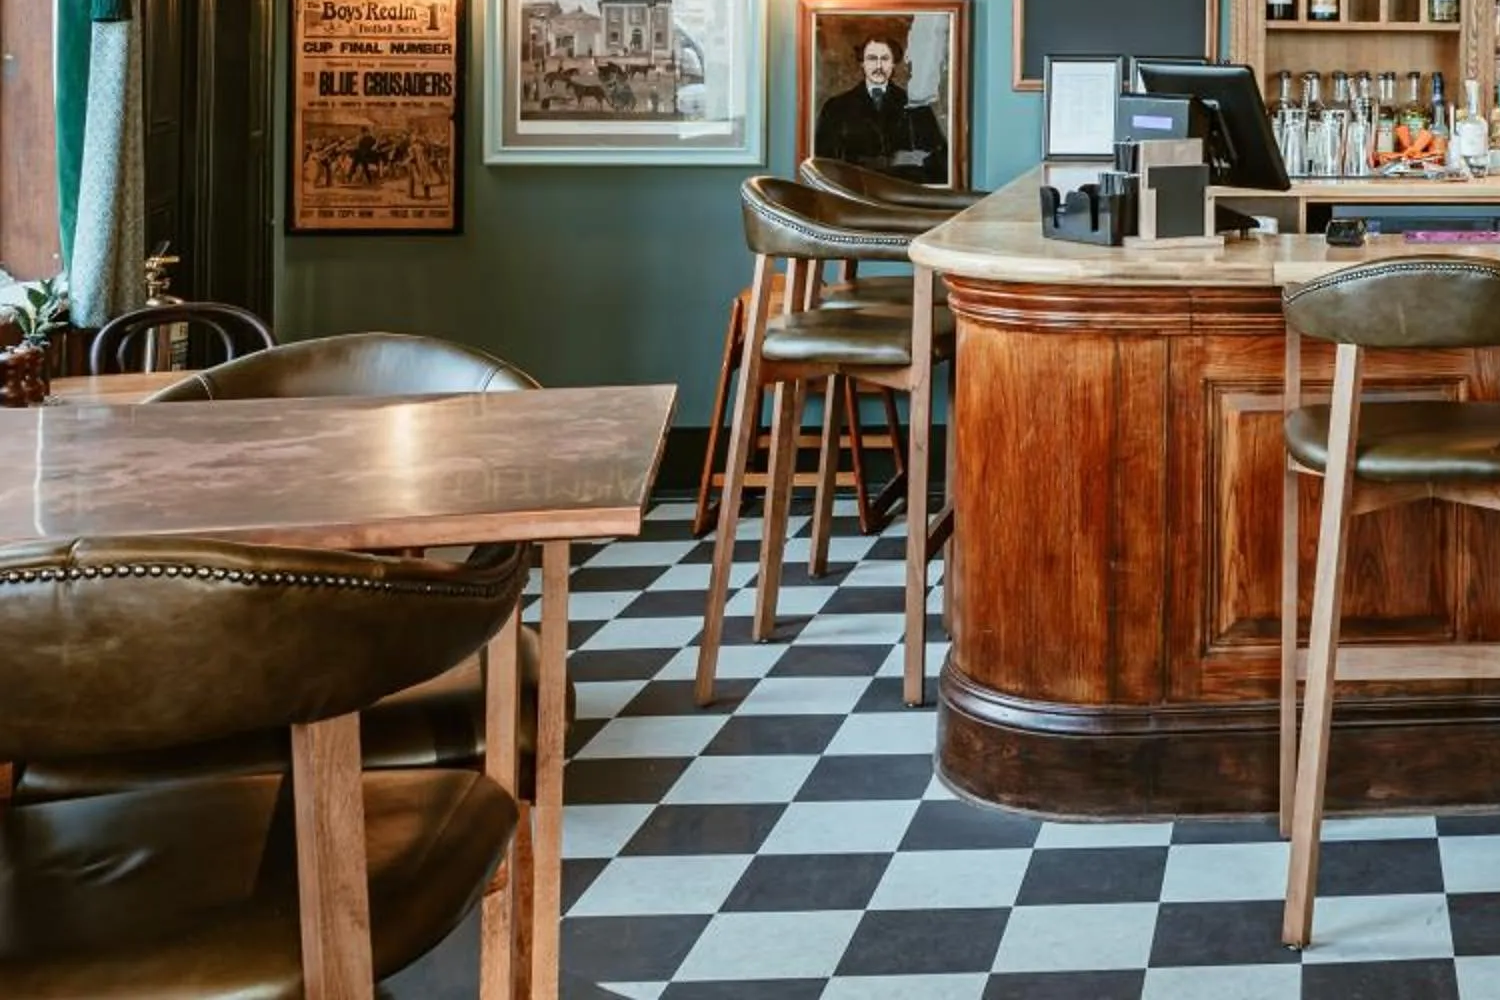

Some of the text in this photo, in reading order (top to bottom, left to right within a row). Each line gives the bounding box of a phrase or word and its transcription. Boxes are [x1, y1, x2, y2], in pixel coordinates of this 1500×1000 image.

[303, 42, 452, 55] CUP FINAL NUMBER
[319, 71, 452, 97] BLUE CRUSADERS
